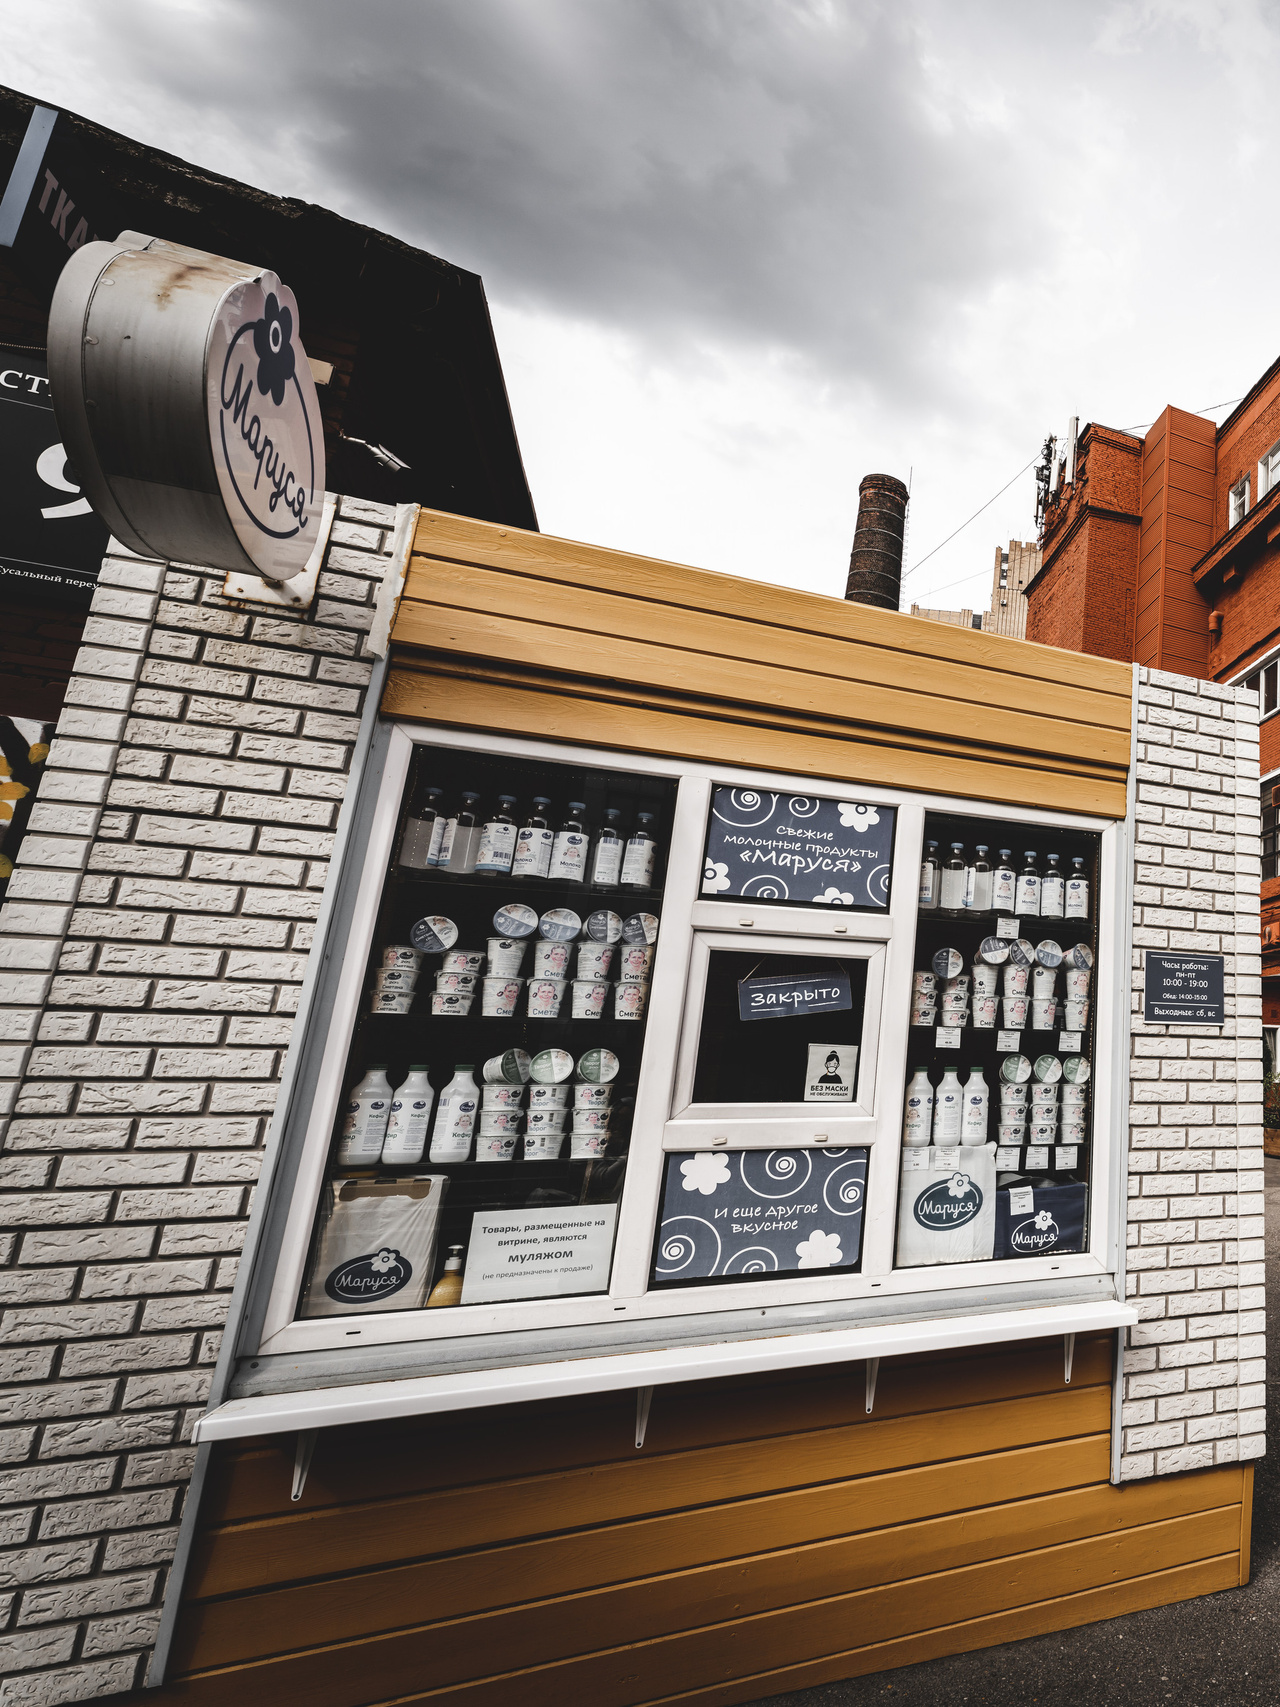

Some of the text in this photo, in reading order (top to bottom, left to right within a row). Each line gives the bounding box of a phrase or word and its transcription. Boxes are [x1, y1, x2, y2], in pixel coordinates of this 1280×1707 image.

[38, 168, 100, 251] ТКА
[0, 369, 52, 397] СТ
[221, 362, 309, 528] Маруся
[723, 834, 879, 859] молочные продукты
[559, 860, 582, 869] Молоко
[739, 849, 862, 875] «Маруся»
[1161, 960, 1209, 971] Часы работы:
[1162, 978, 1183, 987] 10:00
[1189, 979, 1208, 988] 19:00
[1154, 1006, 1195, 1016] Выходные:
[1195, 1009, 1207, 1017] сб,
[732, 1206, 762, 1218] еще
[764, 1203, 819, 1220] другое
[918, 1200, 977, 1219] Маруся
[482, 1219, 606, 1235] Товары, размещенные на
[731, 1220, 799, 1235] вкусное
[497, 1233, 587, 1247] витрине, являются
[1011, 1232, 1058, 1248] Маруся
[508, 1250, 573, 1264] муляжом
[482, 1273, 494, 1281] (не
[495, 1268, 553, 1279] предназначены
[559, 1264, 594, 1274] продаже)
[334, 1273, 400, 1292] Маруся
